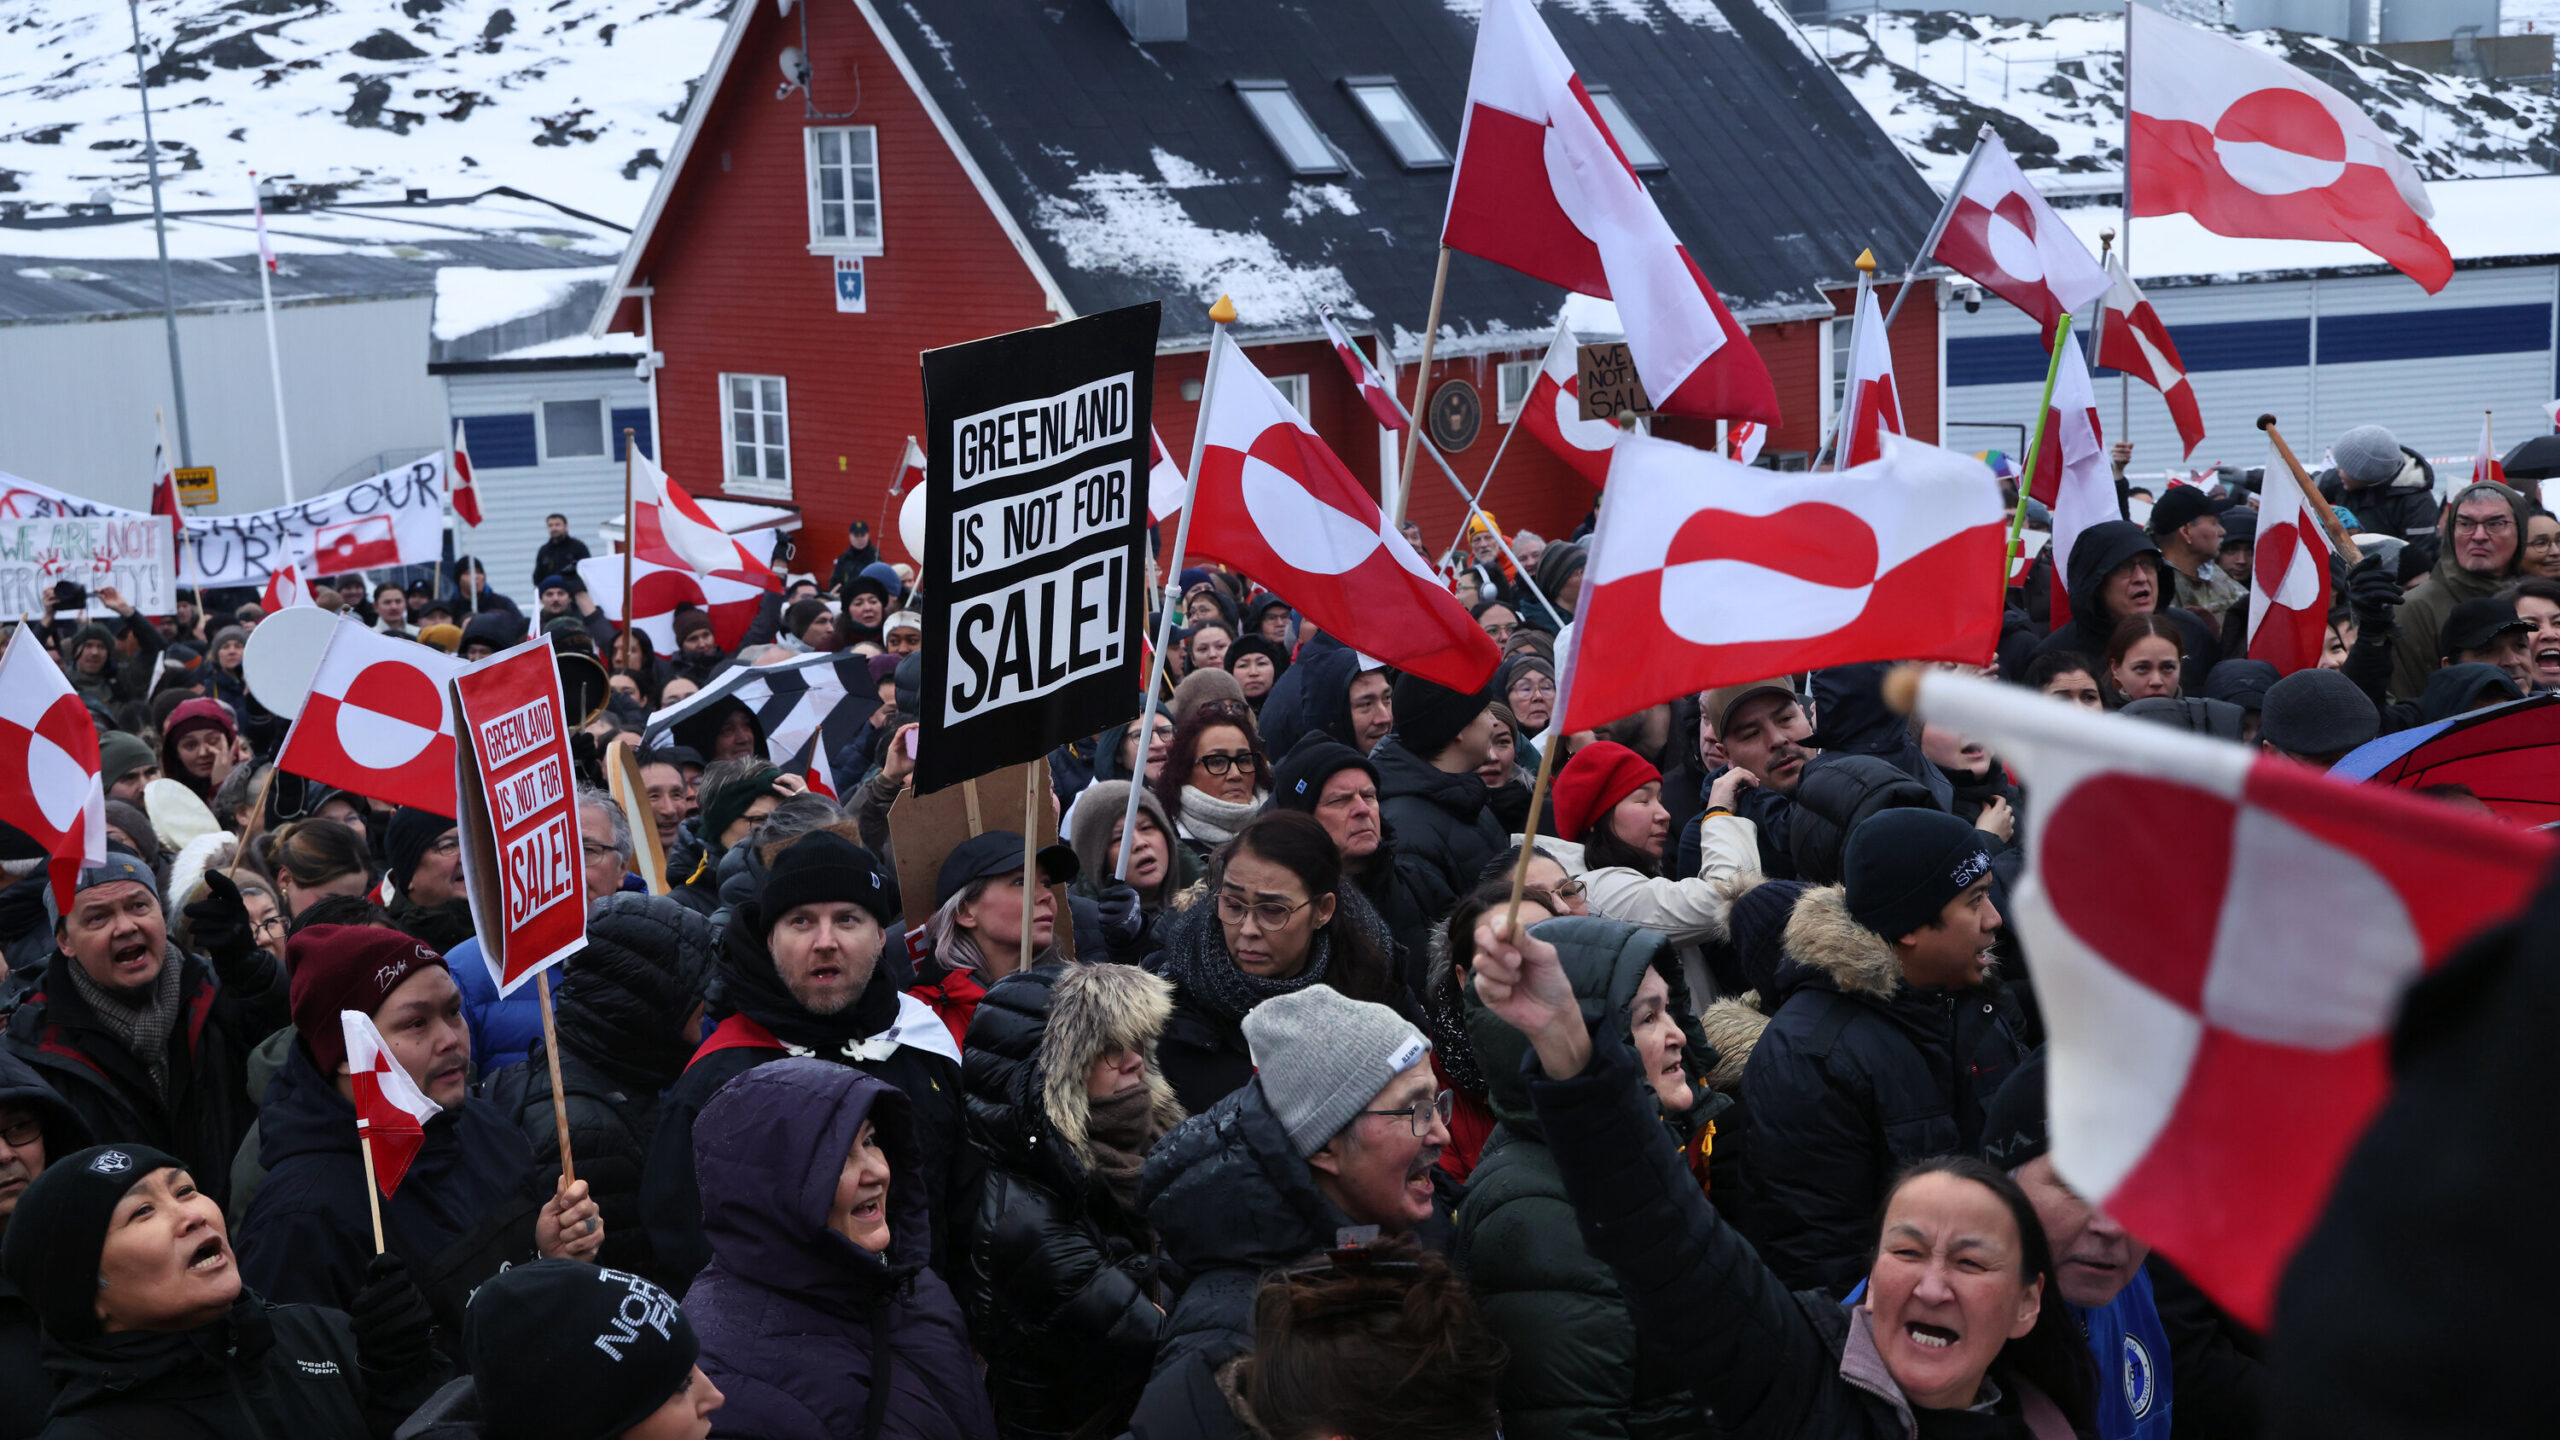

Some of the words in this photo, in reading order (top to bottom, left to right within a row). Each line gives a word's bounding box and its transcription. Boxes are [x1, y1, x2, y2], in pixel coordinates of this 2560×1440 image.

[1588, 344, 1627, 368] WE
[1588, 366, 1628, 390] NOT
[959, 381, 1128, 481] GREENLAND
[345, 462, 439, 515] OUR
[0, 524, 40, 563] WE
[49, 521, 101, 561] ARE
[106, 519, 160, 560] NOT
[958, 513, 984, 572] IS
[1003, 491, 1063, 560] NOT
[1073, 469, 1126, 534] FOR
[952, 557, 1123, 713] SALE!
[485, 704, 552, 763] GREENLAND
[499, 788, 513, 826] IS
[515, 772, 536, 812] NOT
[540, 760, 562, 801] FOR
[511, 819, 572, 922] SALE!
